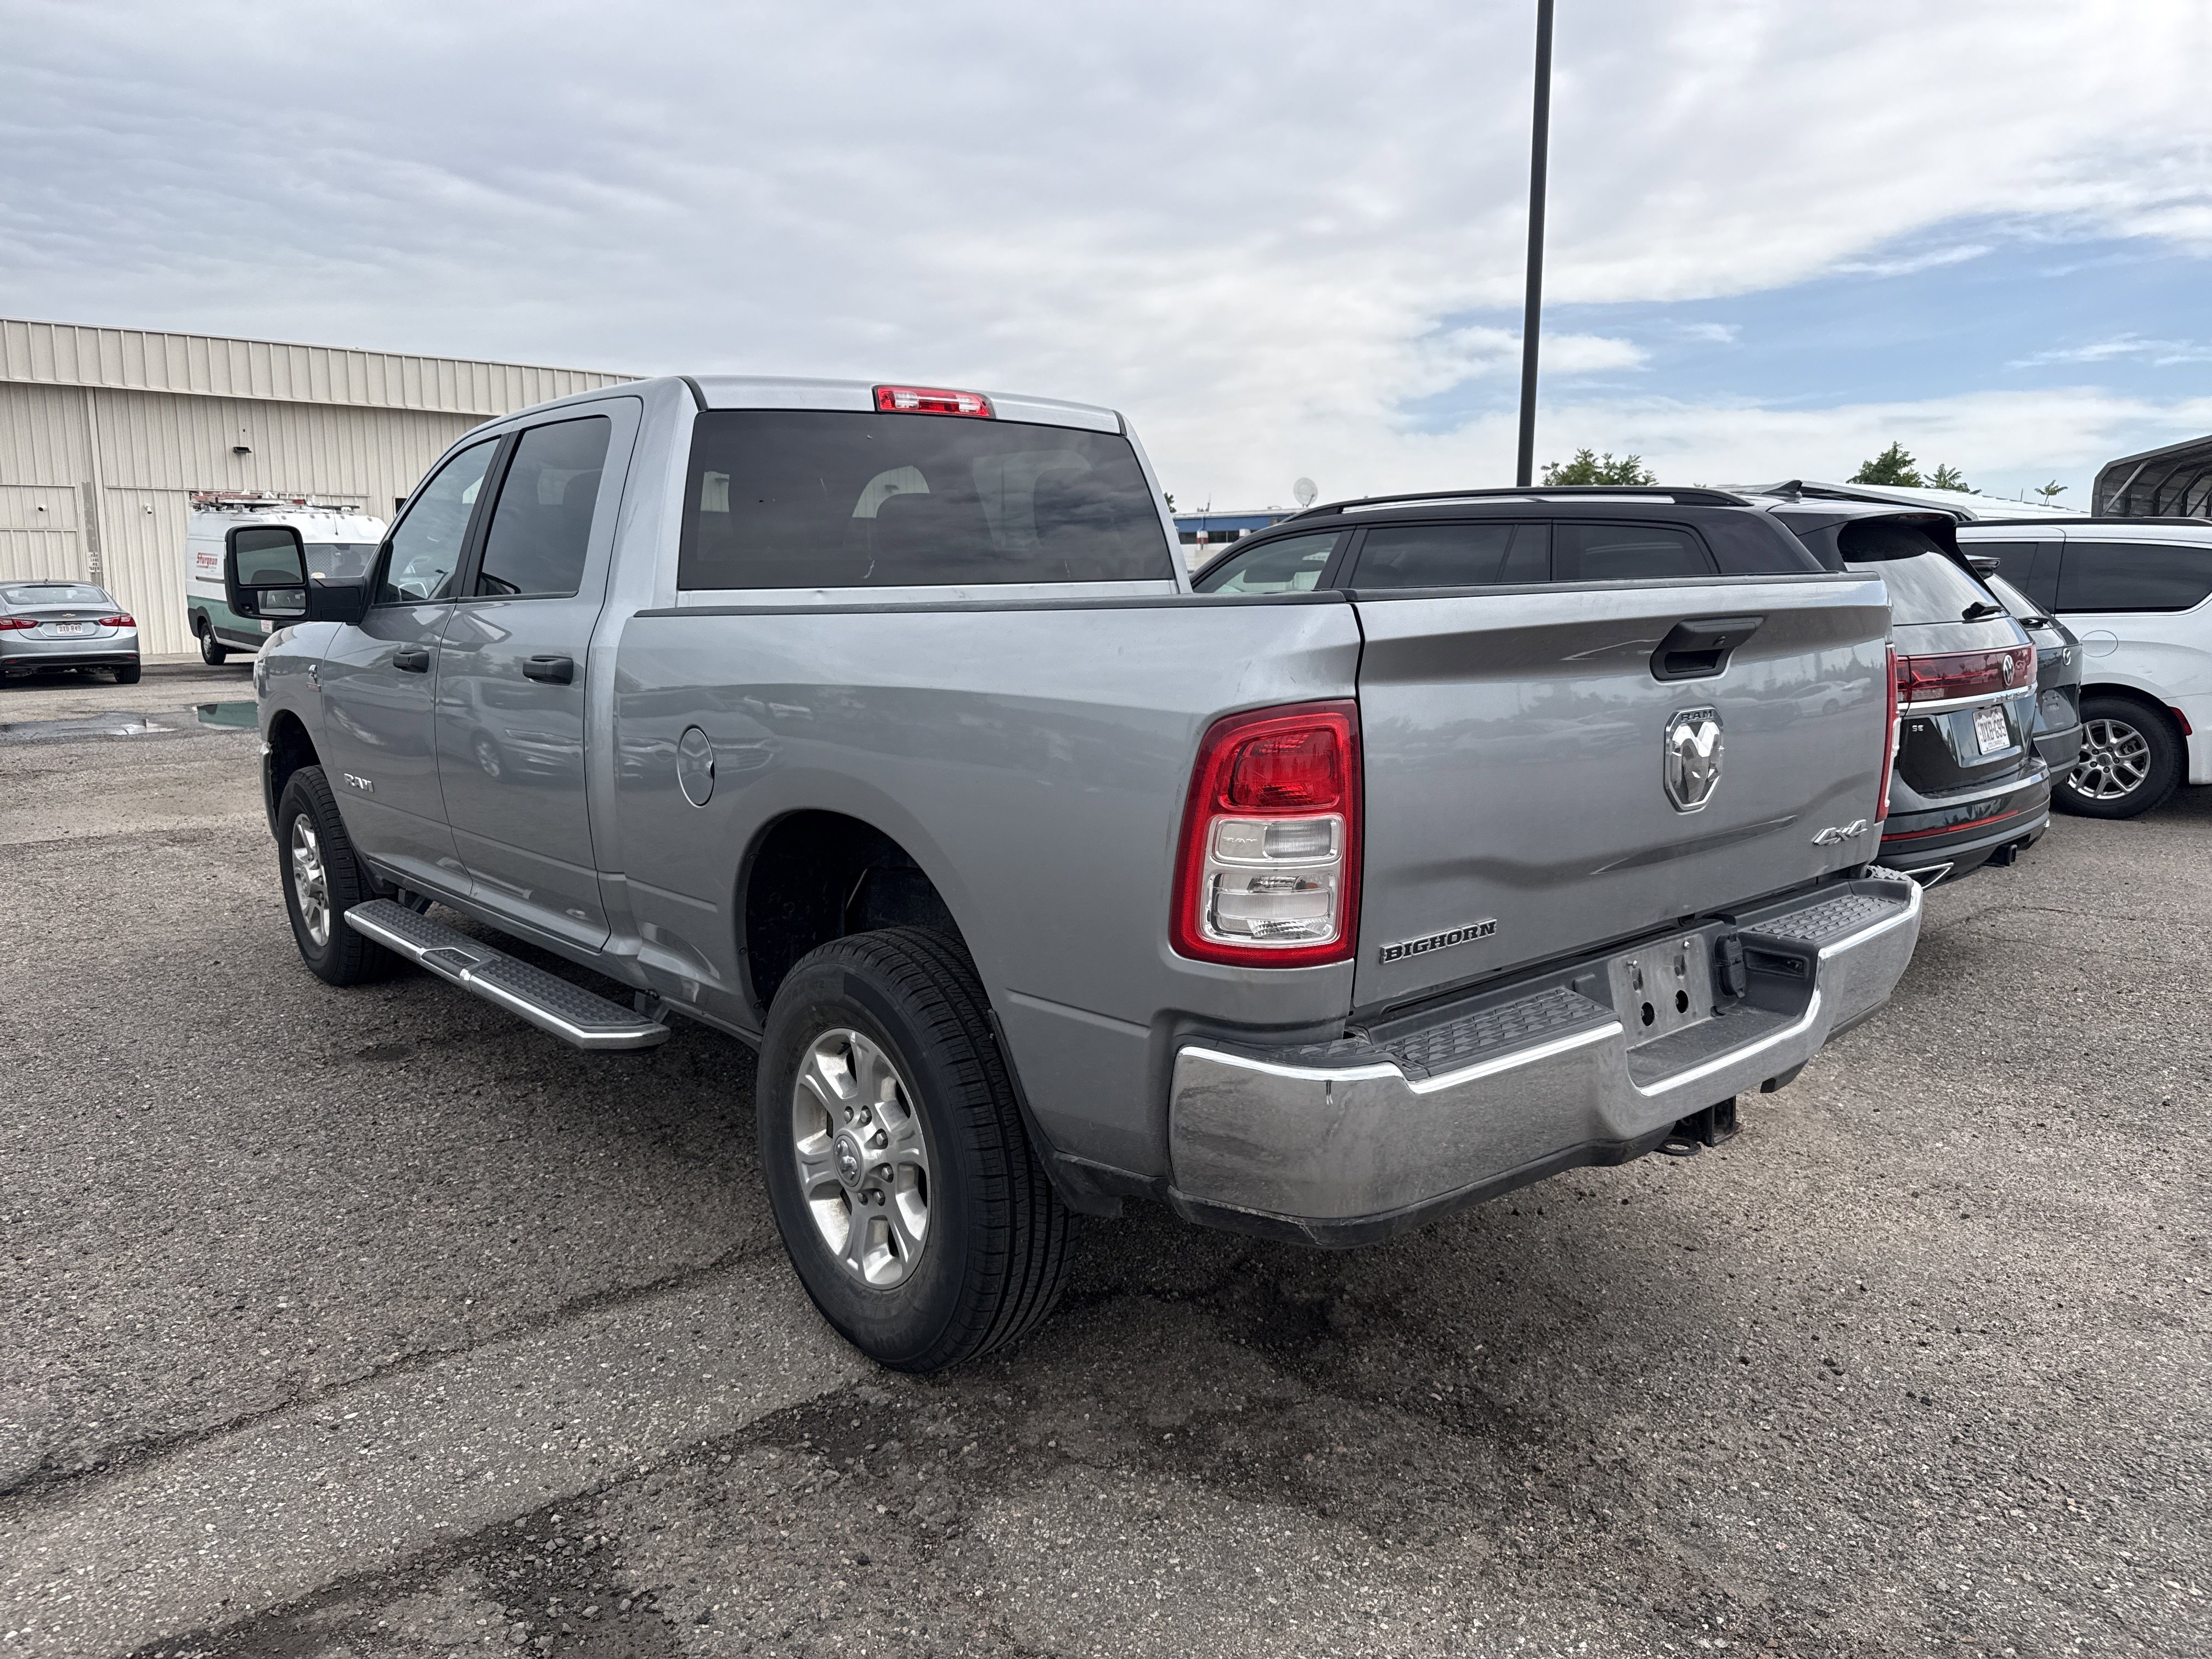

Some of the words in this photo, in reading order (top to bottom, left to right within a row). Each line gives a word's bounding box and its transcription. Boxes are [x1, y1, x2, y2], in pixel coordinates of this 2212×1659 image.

[196, 552, 218, 568] Sturgeon
[1680, 710, 1713, 721] RAM
[344, 773, 374, 793] RAM
[1380, 919, 1497, 964] BIGHORN
